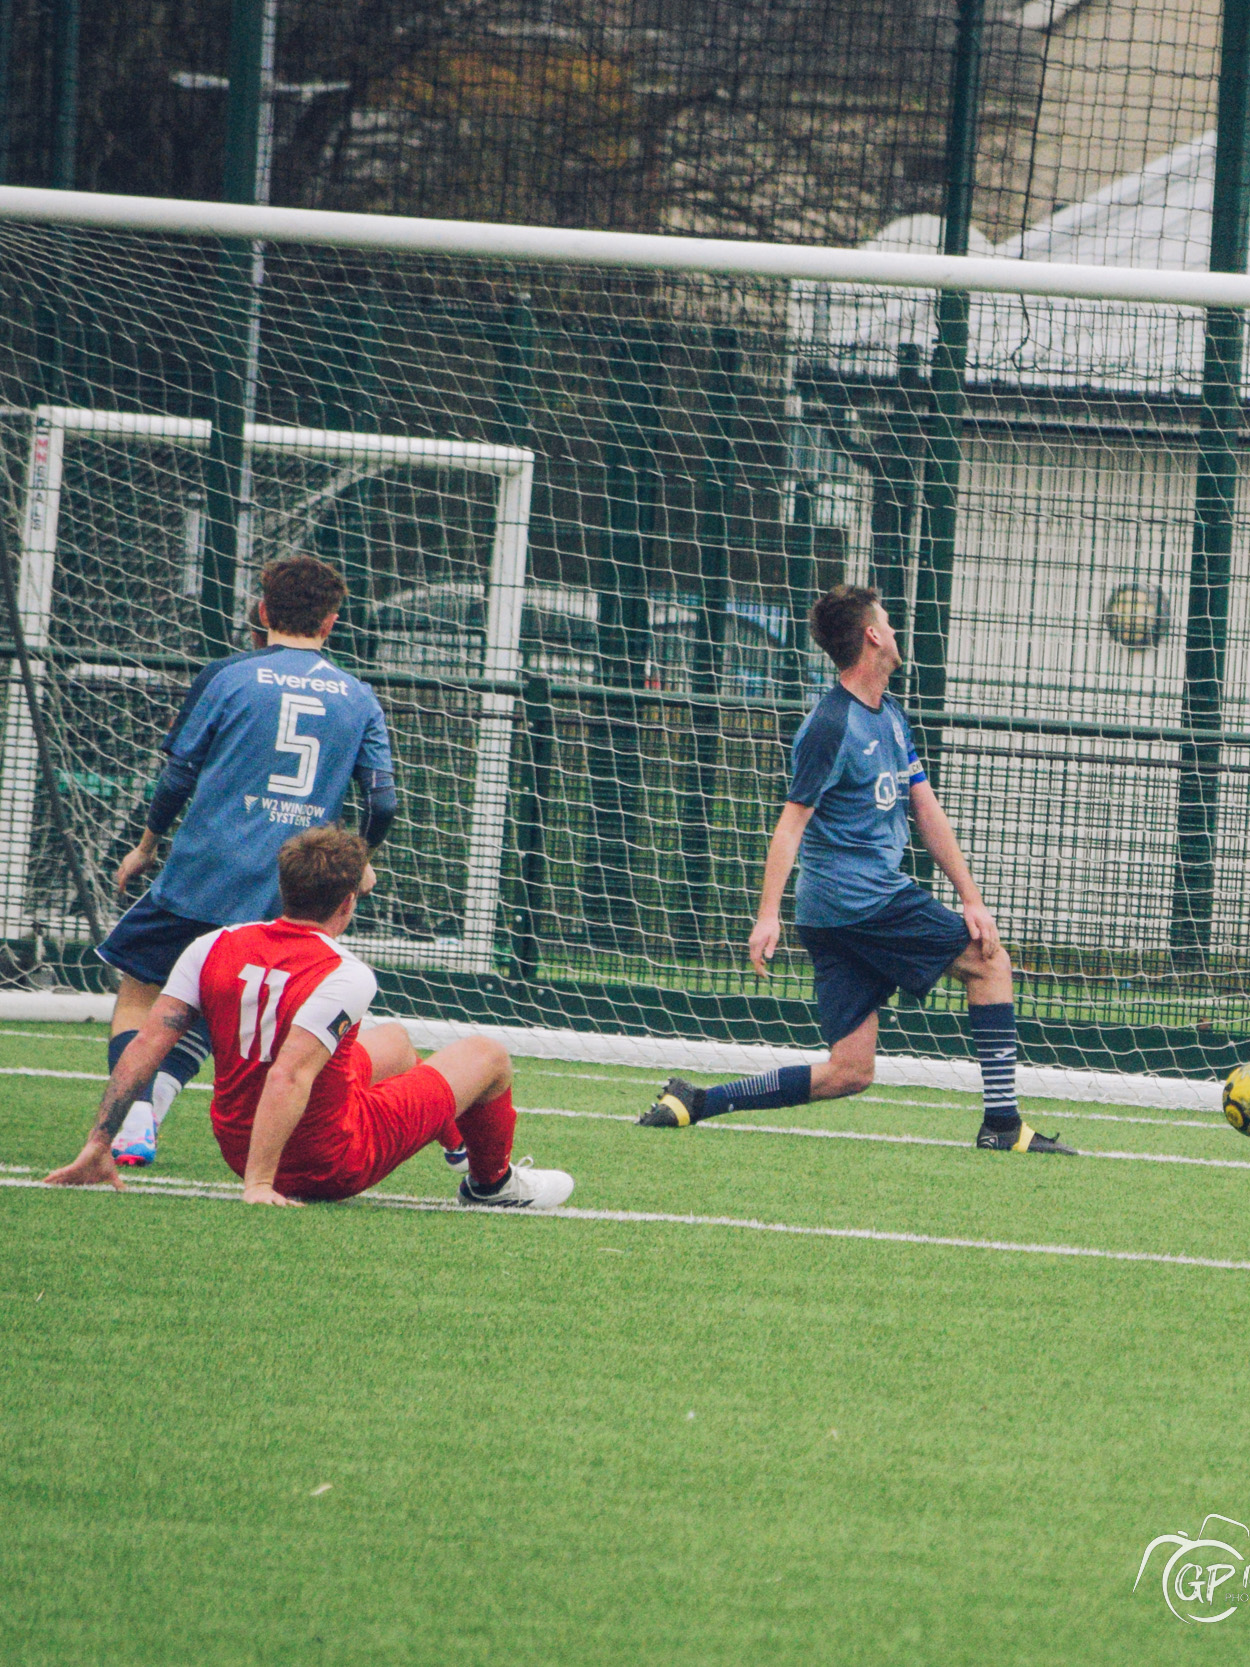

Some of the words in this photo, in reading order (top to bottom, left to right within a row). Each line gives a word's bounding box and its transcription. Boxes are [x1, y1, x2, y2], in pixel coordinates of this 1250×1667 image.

[257, 668, 349, 696] Everest
[267, 692, 326, 797] 5
[262, 798, 279, 811] W2
[237, 963, 292, 1063] 11
